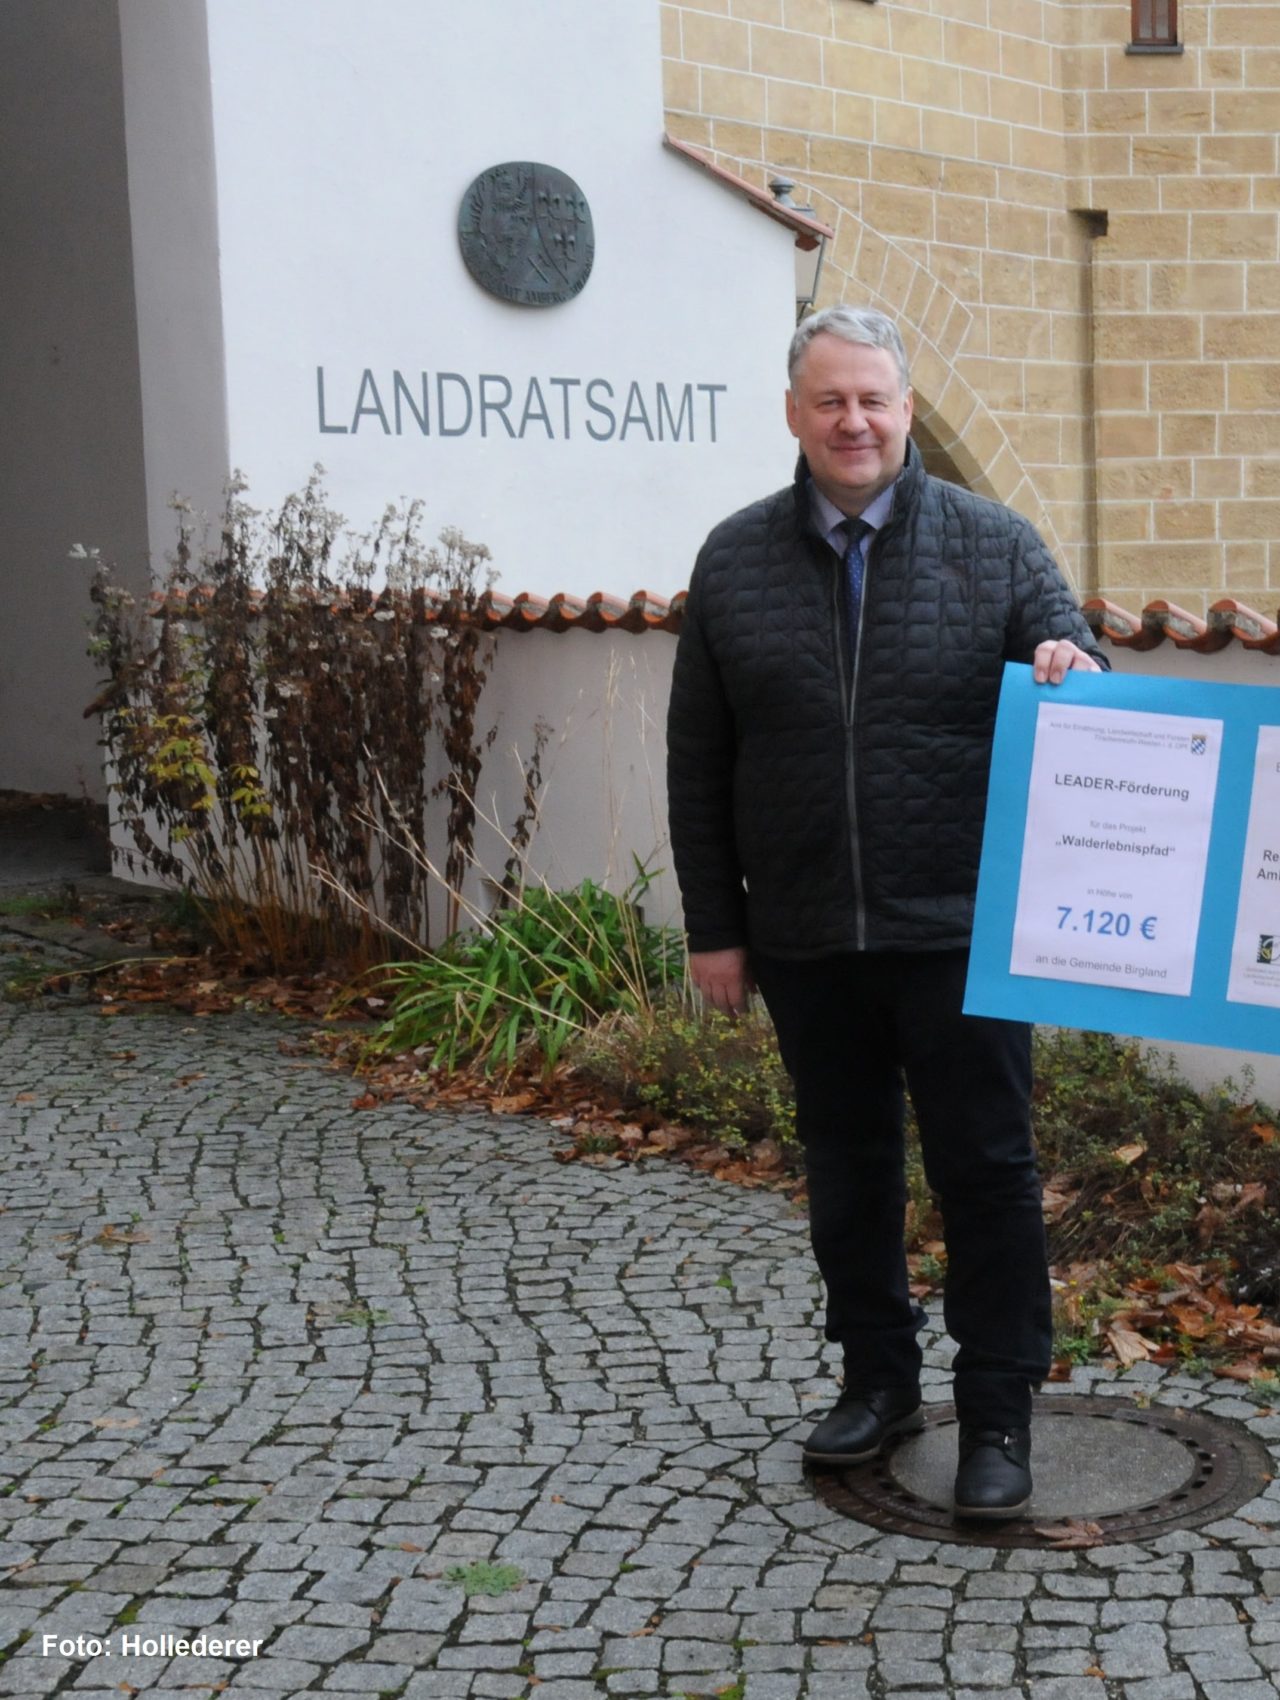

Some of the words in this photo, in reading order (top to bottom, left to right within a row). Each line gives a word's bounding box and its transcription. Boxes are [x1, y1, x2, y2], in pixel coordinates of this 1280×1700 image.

[317, 365, 728, 443] LANDRATSAMT
[1054, 773, 1190, 801] LEADER-Förderung
[1102, 821, 1117, 830] das
[1119, 822, 1147, 834] Projekt
[1057, 906, 1131, 937] 7.120
[1140, 916, 1158, 940] €
[1035, 955, 1048, 964] an
[1051, 955, 1067, 967] die
[1069, 957, 1122, 973] Gemeinde
[1125, 963, 1168, 979] Birgland
